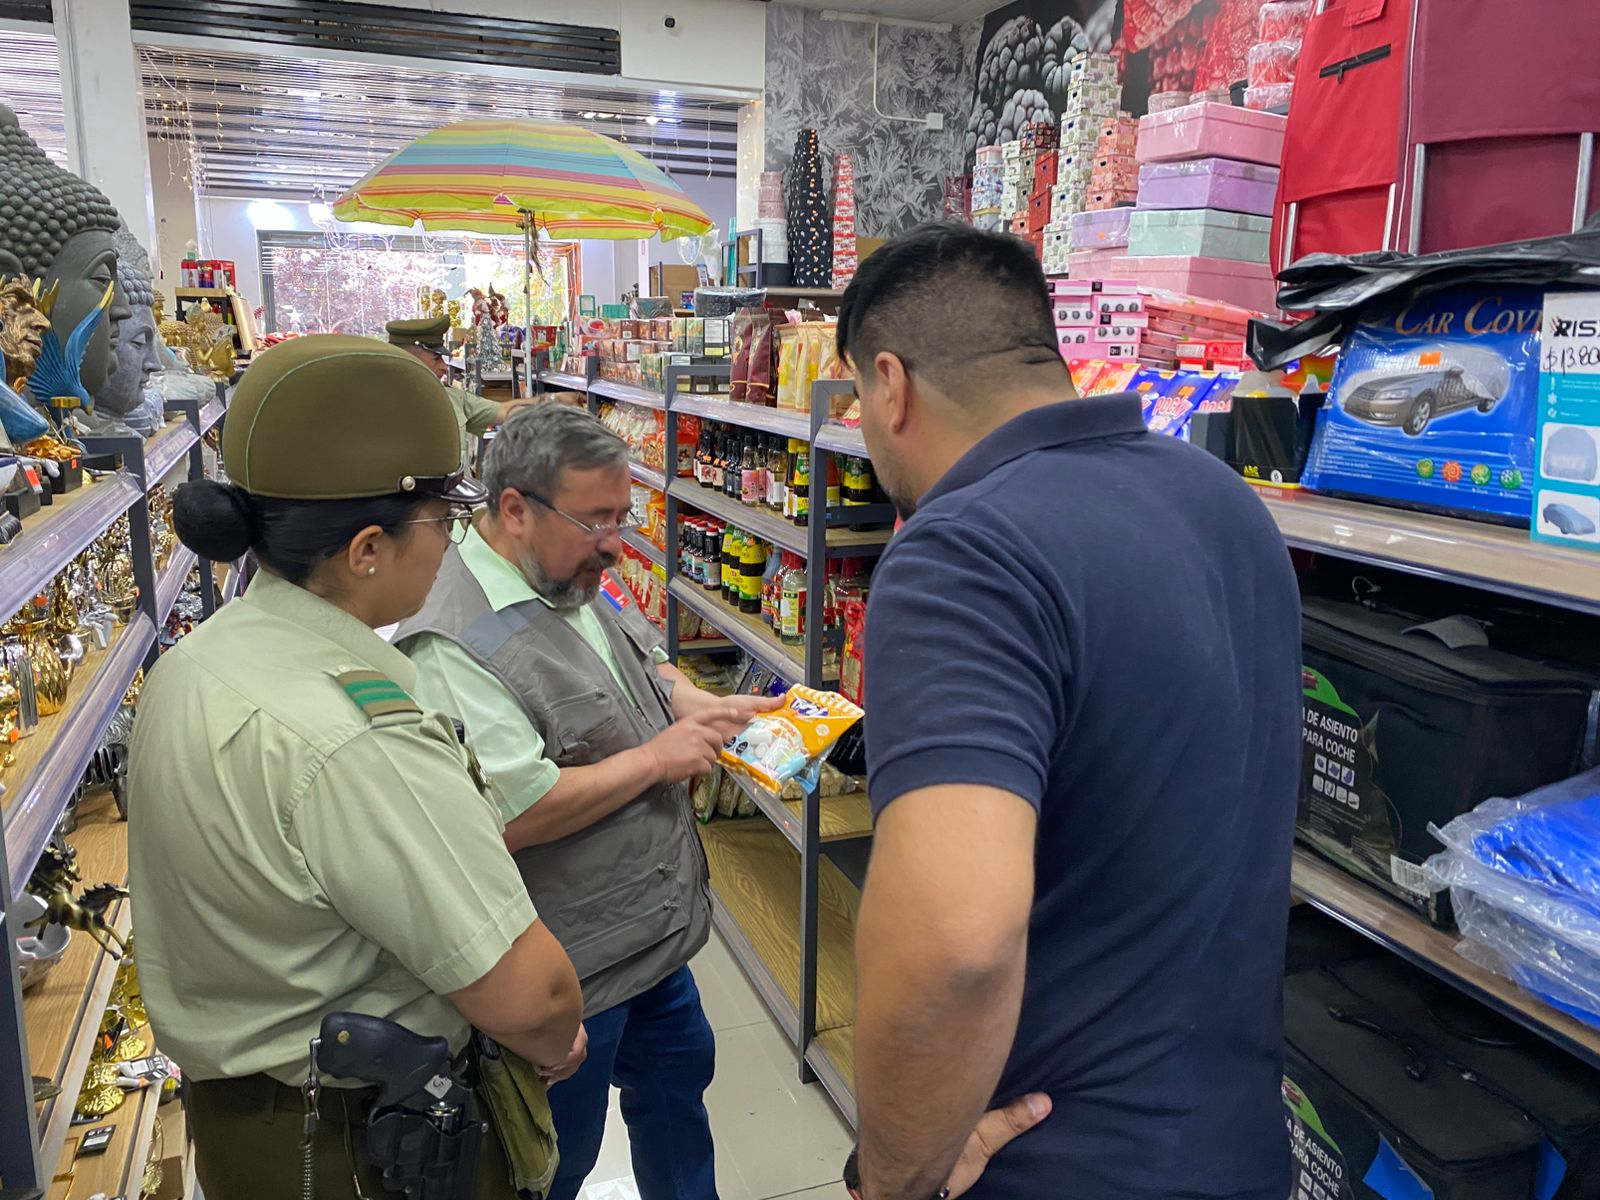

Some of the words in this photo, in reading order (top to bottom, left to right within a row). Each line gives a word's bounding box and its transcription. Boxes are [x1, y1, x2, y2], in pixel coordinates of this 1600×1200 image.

[1307, 709, 1319, 726] DE
[1320, 715, 1358, 743] ASIENTO
[1302, 727, 1324, 750] PARA
[1325, 738, 1356, 763] COCHE
[1293, 1124, 1305, 1143] DE
[1305, 1137, 1342, 1179] ASIENTO
[1311, 1161, 1340, 1197] COCHE
